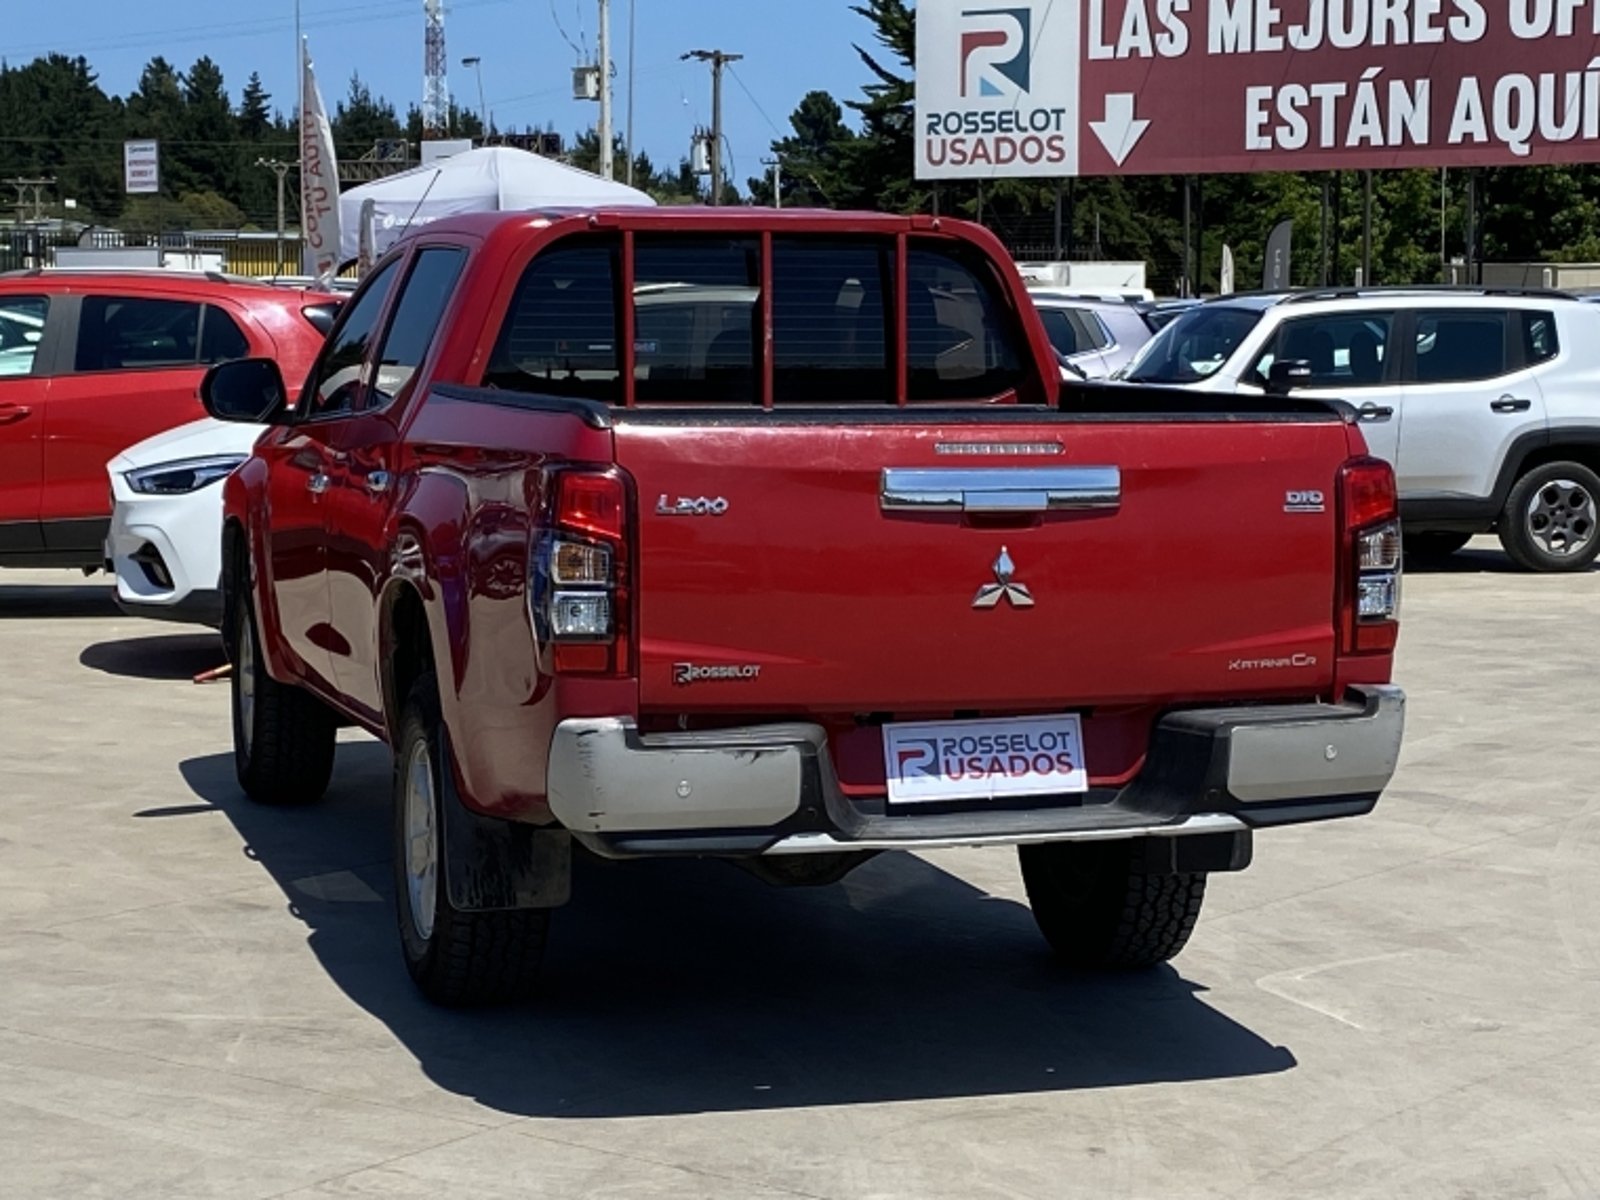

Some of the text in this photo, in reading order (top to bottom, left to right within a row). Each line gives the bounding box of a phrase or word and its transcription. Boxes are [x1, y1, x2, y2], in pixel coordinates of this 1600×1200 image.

[1088, 0, 1189, 59] LAS
[1208, 0, 1487, 54] MEJORES
[1245, 56, 1600, 156] ESTÁN AQUÍ
[926, 109, 1066, 135] ROSSELOT
[926, 135, 1066, 167] USADOS
[656, 494, 729, 515] L200
[691, 664, 761, 680] ROSSELOT
[942, 732, 1070, 757] ROSSELOT
[944, 752, 1074, 781] USADOS
